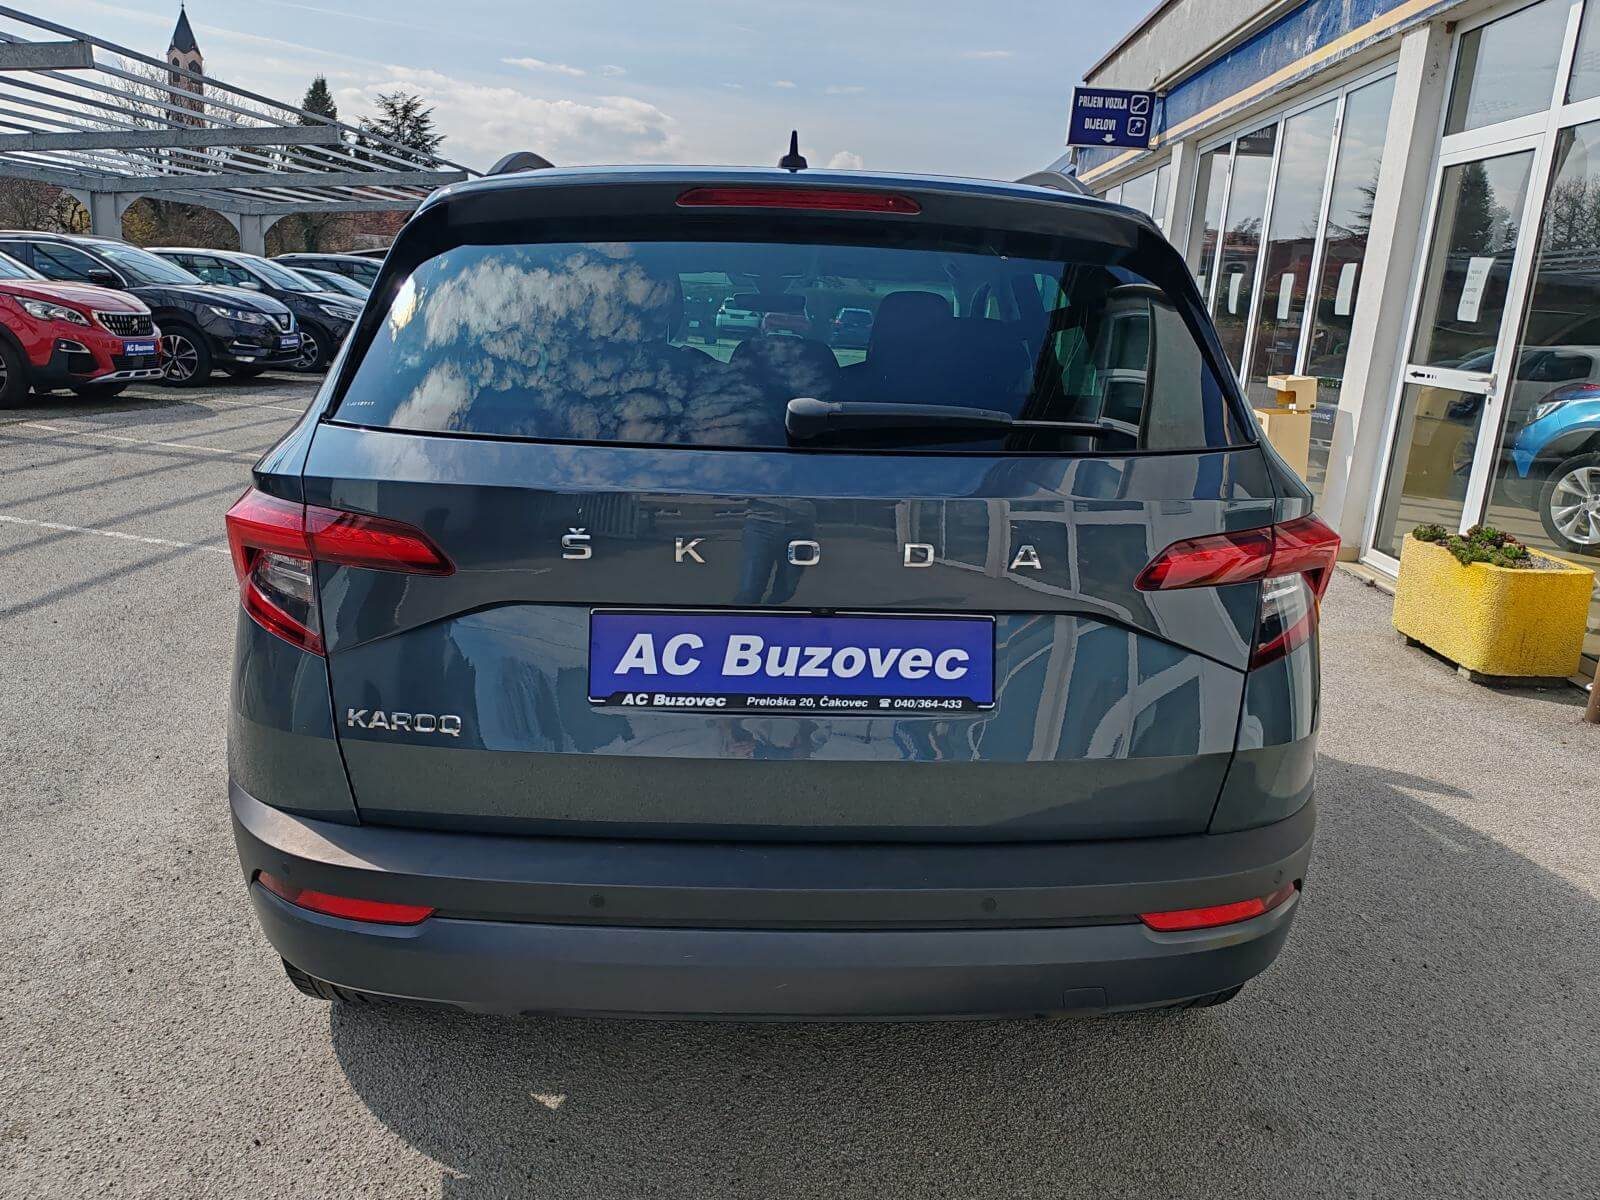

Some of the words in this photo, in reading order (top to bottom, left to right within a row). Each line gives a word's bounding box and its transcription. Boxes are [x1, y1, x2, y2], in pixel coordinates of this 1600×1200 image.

[1078, 95, 1103, 108] PRIJEM
[1105, 97, 1128, 110] VOZILA
[1084, 117, 1116, 131] DIJELOVI
[562, 528, 1042, 570] ŠKODA
[613, 633, 704, 676] AC
[721, 634, 970, 680] Buzovec
[621, 693, 649, 706] AC
[652, 693, 727, 707] Buzovec
[746, 695, 797, 707] Preloška
[798, 697, 817, 708] 20,
[819, 695, 869, 708] Čakovec
[893, 698, 963, 709] 040/364-433
[347, 708, 461, 737] KAROQ
